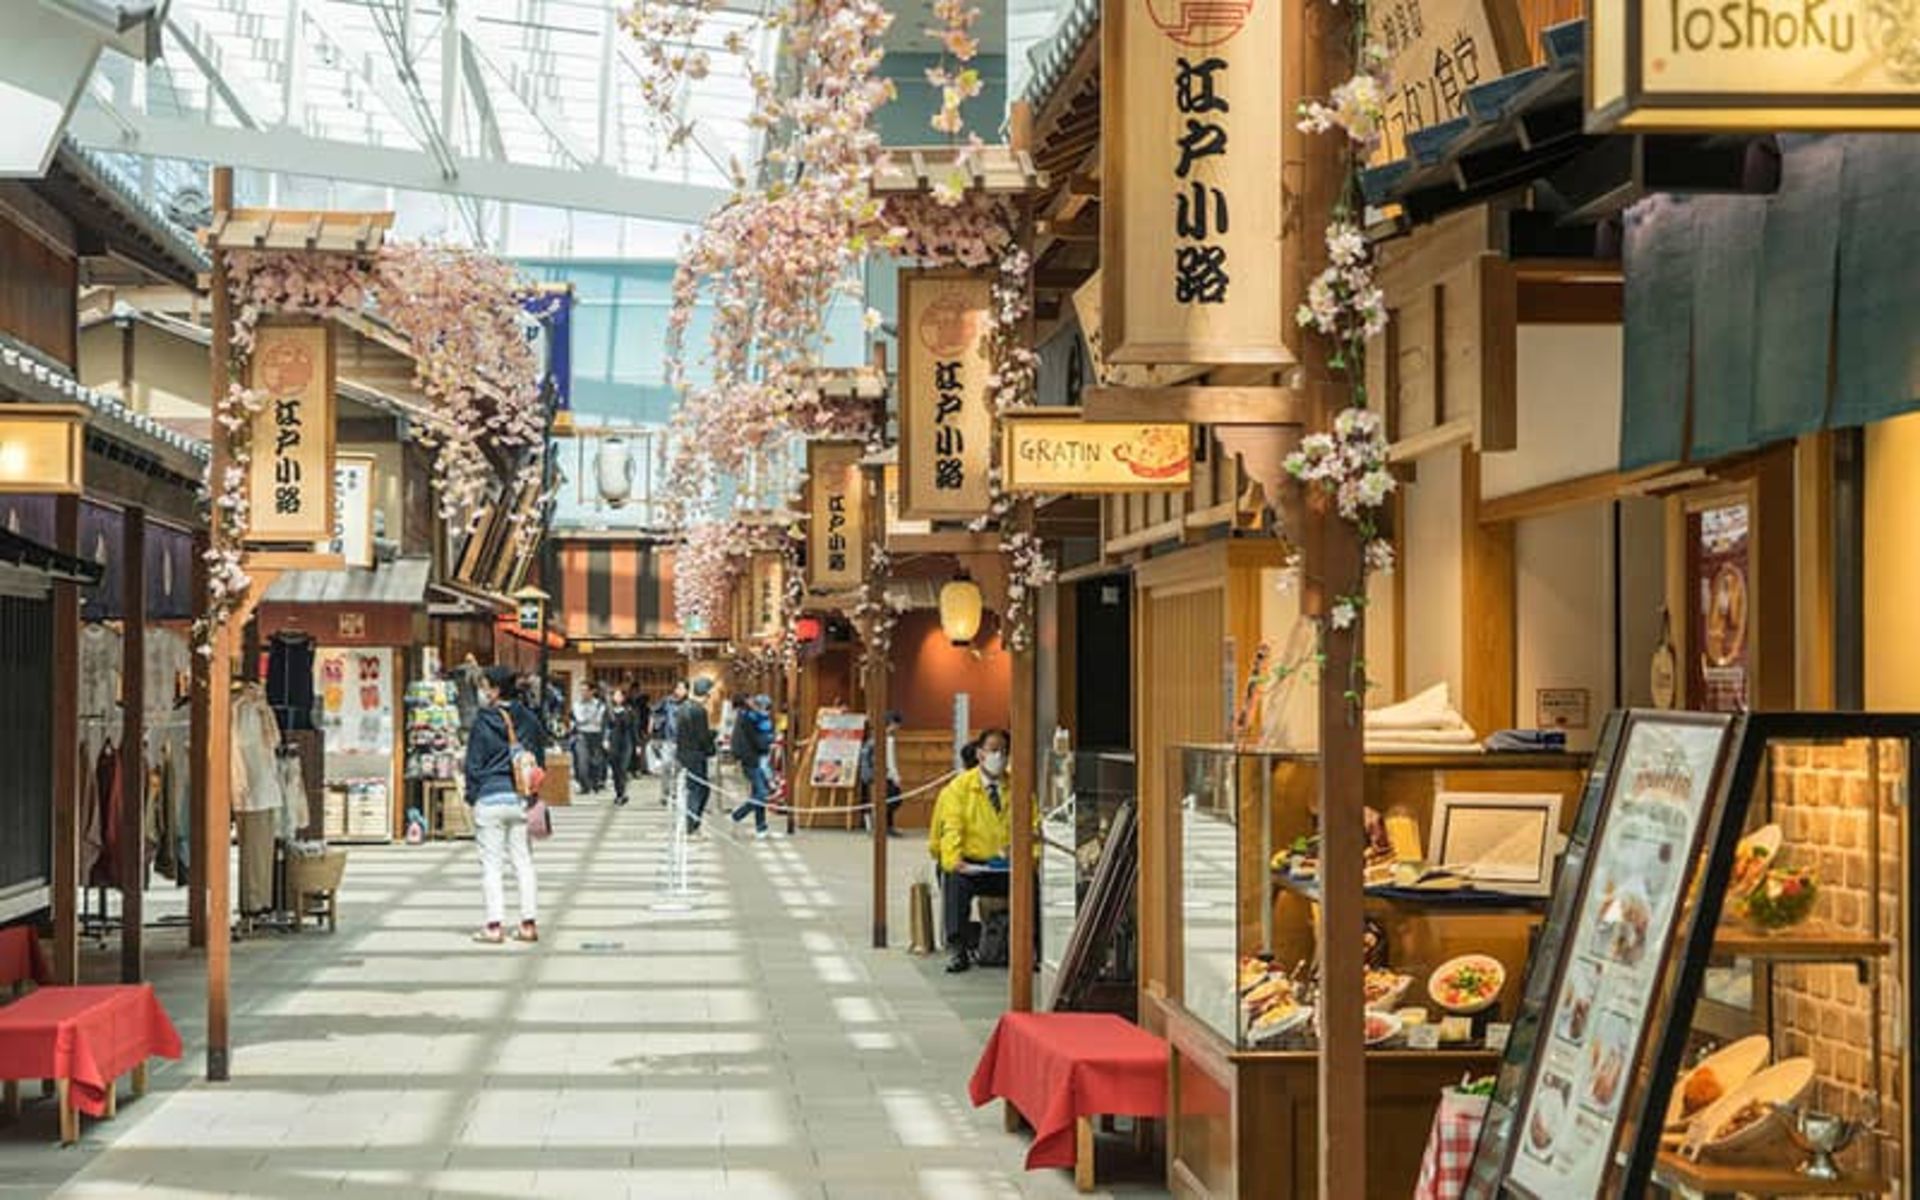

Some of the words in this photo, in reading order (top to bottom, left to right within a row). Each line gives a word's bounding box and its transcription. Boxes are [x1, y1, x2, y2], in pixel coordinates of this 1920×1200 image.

[1175, 57, 1230, 304] 江戸小路
[275, 399, 303, 515] 江戸小路
[935, 361, 964, 489] 江戸小路
[1020, 438, 1100, 462] GRATIN
